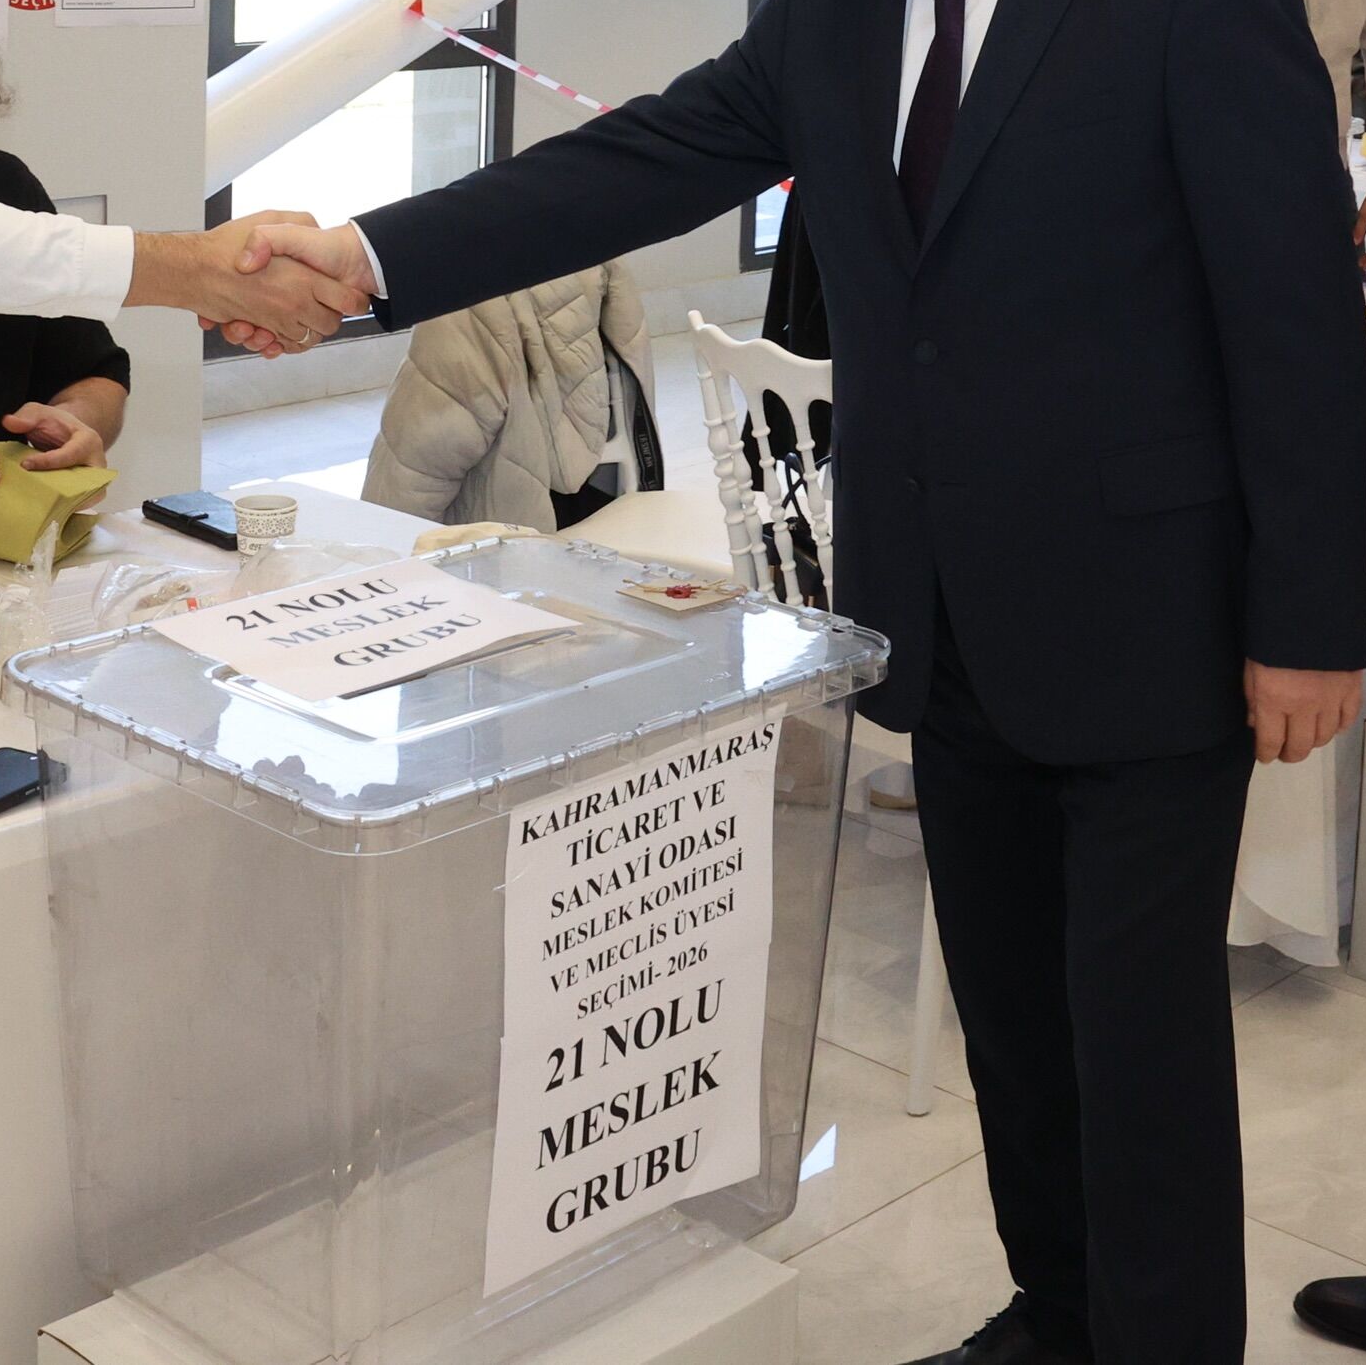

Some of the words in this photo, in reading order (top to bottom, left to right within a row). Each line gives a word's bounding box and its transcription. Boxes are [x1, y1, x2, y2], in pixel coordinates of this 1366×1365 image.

[226, 609, 278, 631] 21
[275, 578, 398, 618] NOLU
[266, 595, 450, 649] MESLEK
[333, 613, 482, 667] GRUBU
[520, 722, 776, 846] KAHRAMANMARAŞ
[566, 795, 685, 867] TİCARET
[692, 779, 726, 813] VE
[541, 900, 634, 962] MESLEK
[639, 847, 744, 916] KOMİTESİ
[550, 846, 652, 920] SANAYİ
[658, 814, 737, 870] ODASI
[550, 963, 579, 994] VE
[585, 923, 668, 979] MECLİS
[674, 887, 736, 936] ÜYESİ
[577, 961, 662, 1020] SEÇİMİ-
[667, 940, 708, 977] 2026
[544, 1036, 585, 1093] 21
[599, 978, 726, 1068] NOLU
[535, 1049, 722, 1171] MESLEK
[545, 1127, 703, 1234] GRUBU
